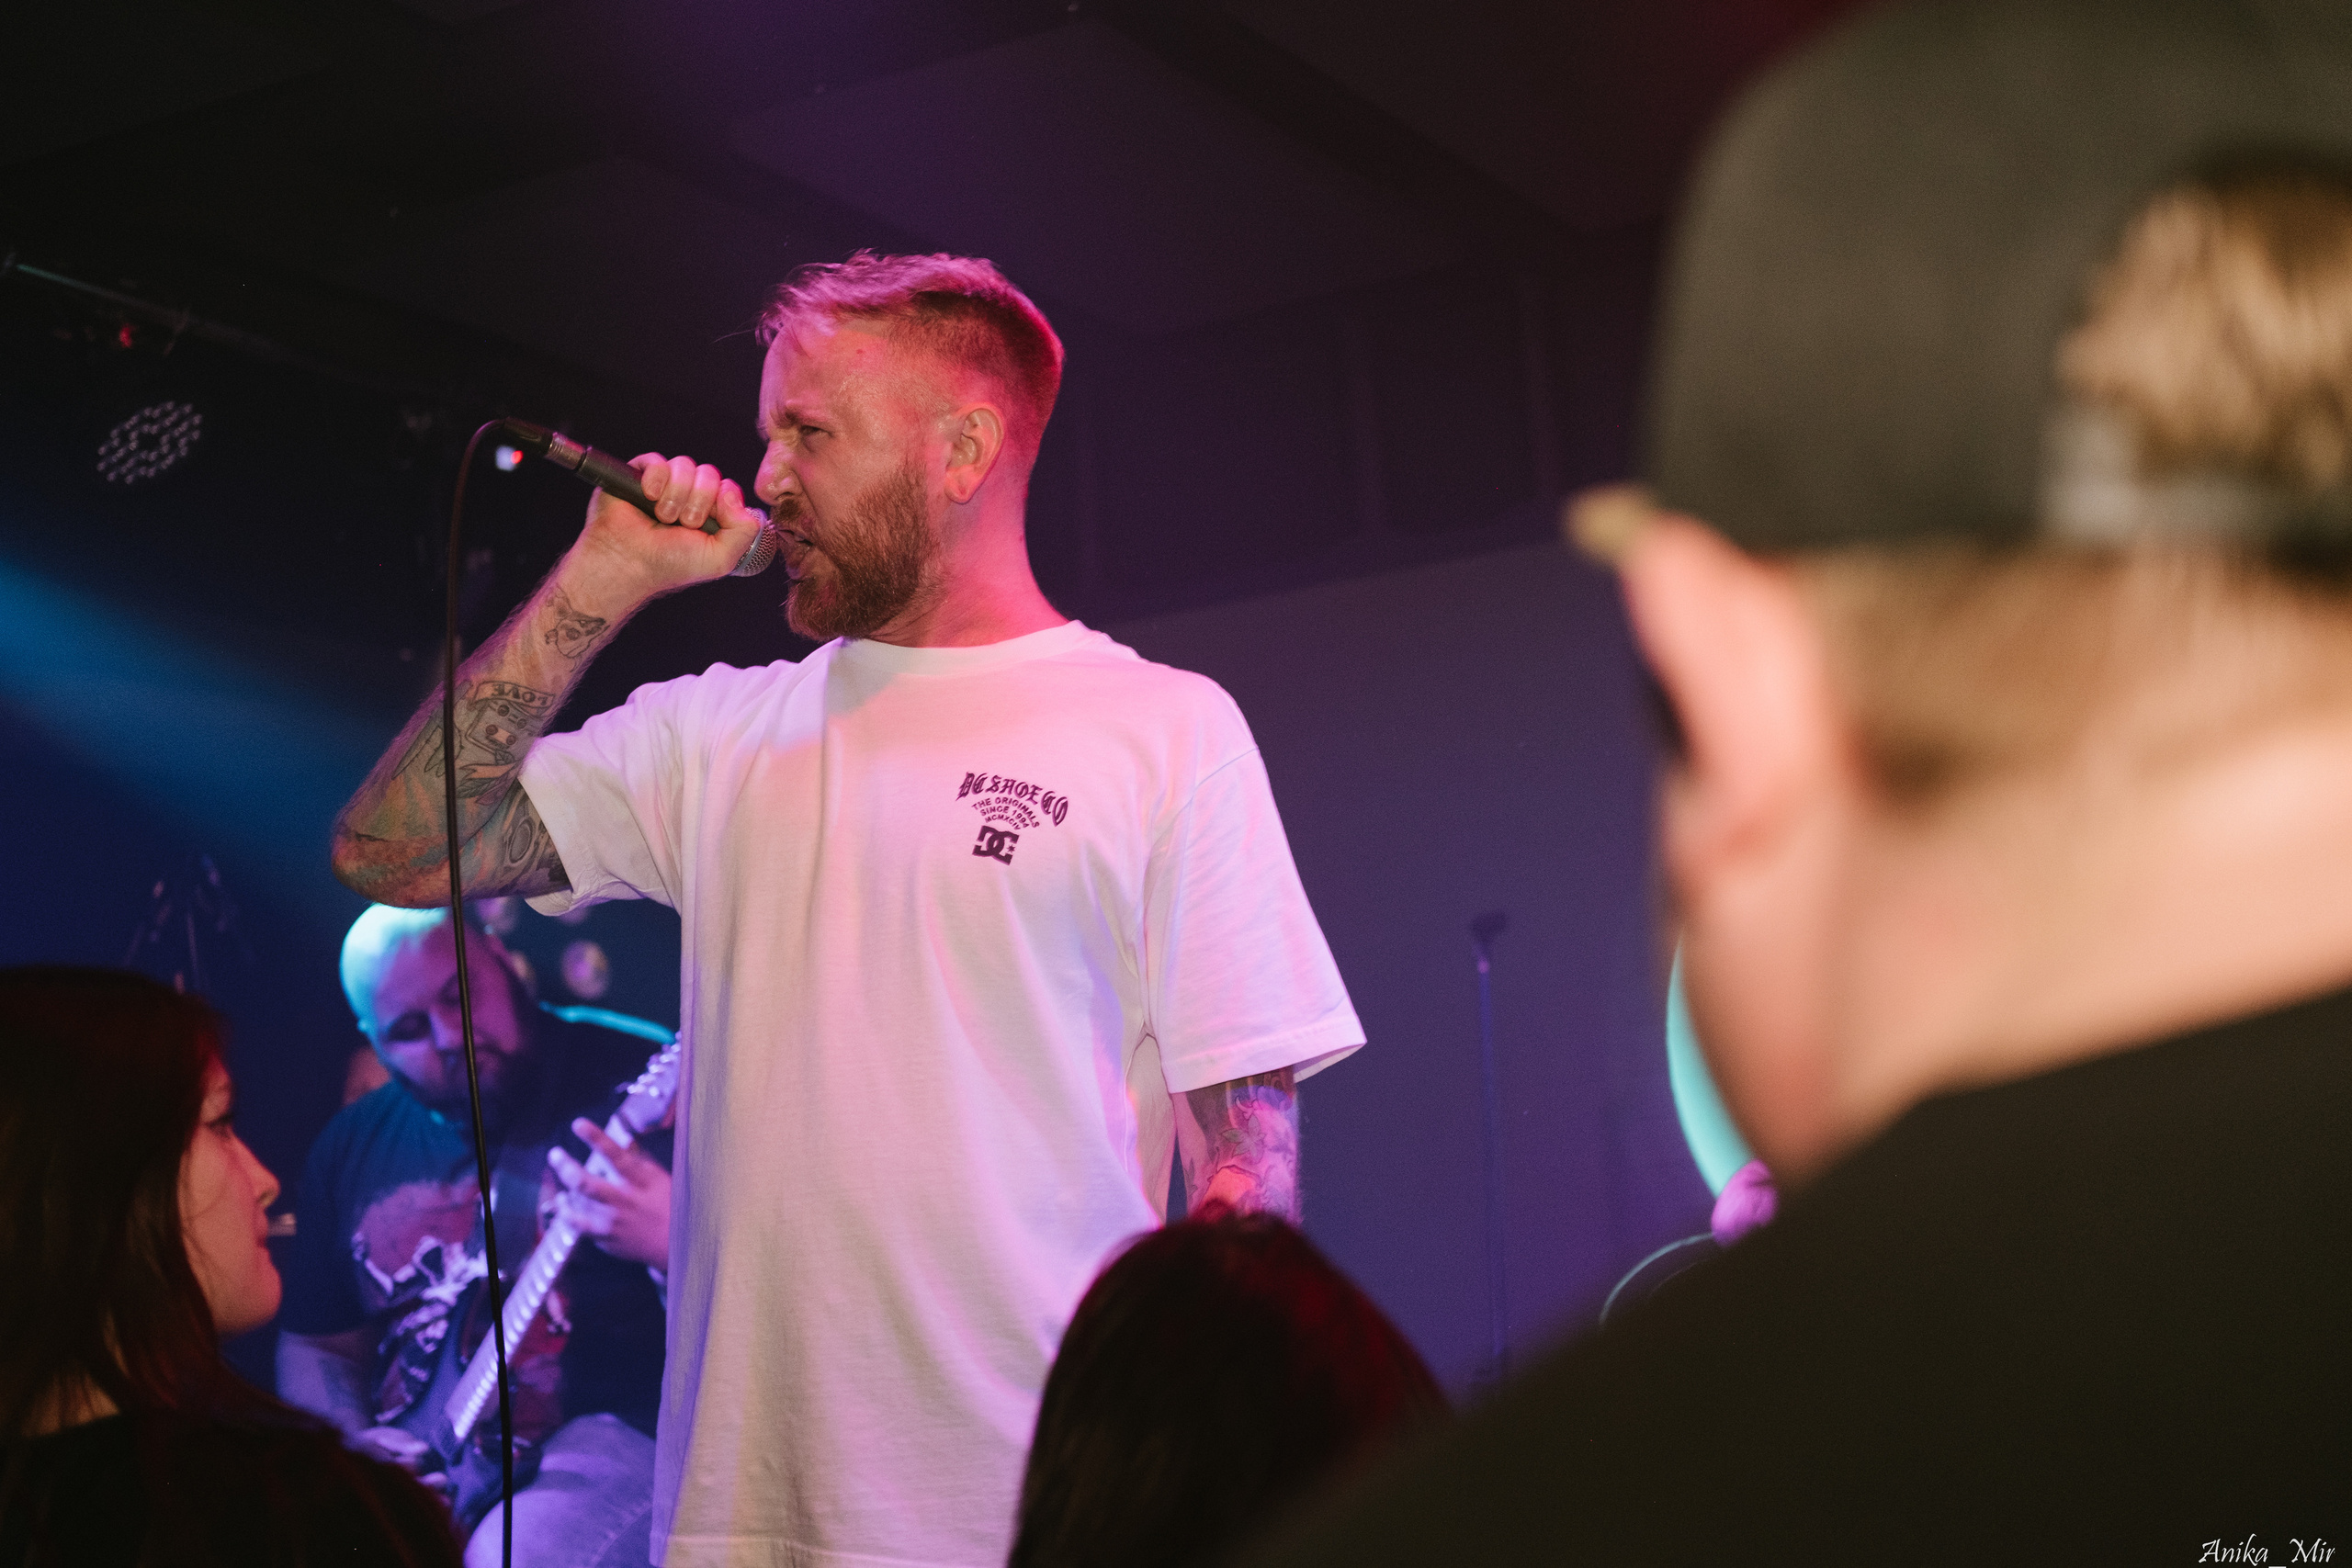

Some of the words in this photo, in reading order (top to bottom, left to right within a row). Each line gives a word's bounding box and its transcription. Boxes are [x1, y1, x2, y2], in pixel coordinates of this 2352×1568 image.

[492, 683, 548, 705] LOVE
[971, 797, 991, 810] THE
[995, 796, 1040, 828] ORIGINALS
[980, 806, 1010, 817] SINCE
[1012, 809, 1029, 829] 1994
[985, 815, 1021, 830] MCMXCIV
